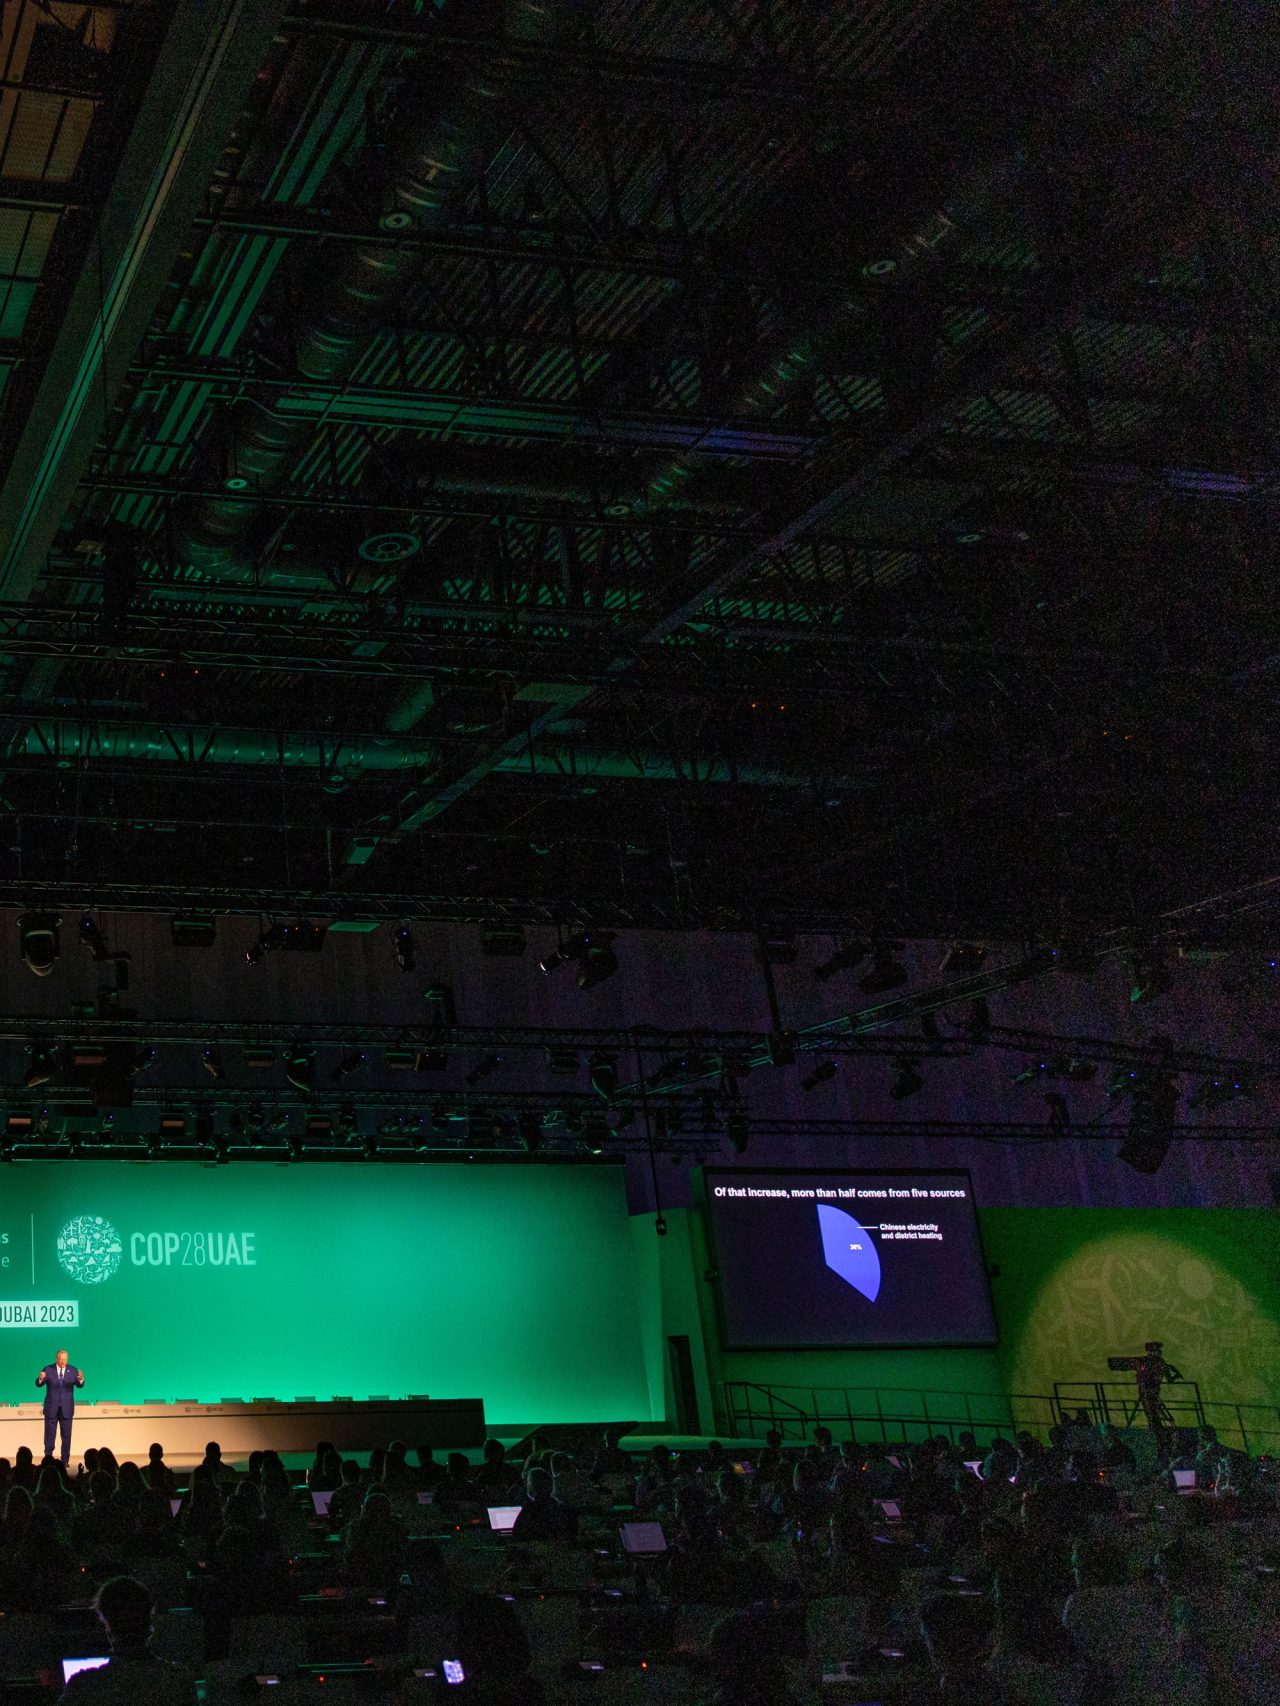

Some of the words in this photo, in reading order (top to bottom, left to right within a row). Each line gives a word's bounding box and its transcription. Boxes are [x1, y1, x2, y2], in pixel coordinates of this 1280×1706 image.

[714, 1186, 727, 1197] Of
[727, 1187, 747, 1197] that
[747, 1187, 790, 1199] increase,
[790, 1189, 816, 1198] more
[815, 1187, 838, 1198] than
[838, 1188, 856, 1198] half
[856, 1190, 888, 1198] comes
[888, 1187, 911, 1198] from
[910, 1188, 929, 1198] five
[929, 1190, 966, 1198] sources
[879, 1223, 907, 1231] Chinese
[906, 1223, 939, 1233] electricity
[880, 1232, 895, 1240] and
[894, 1231, 919, 1240] district
[917, 1232, 943, 1241] heating
[130, 1231, 257, 1267] COP28UAE
[40, 1304, 75, 1323] 2023
